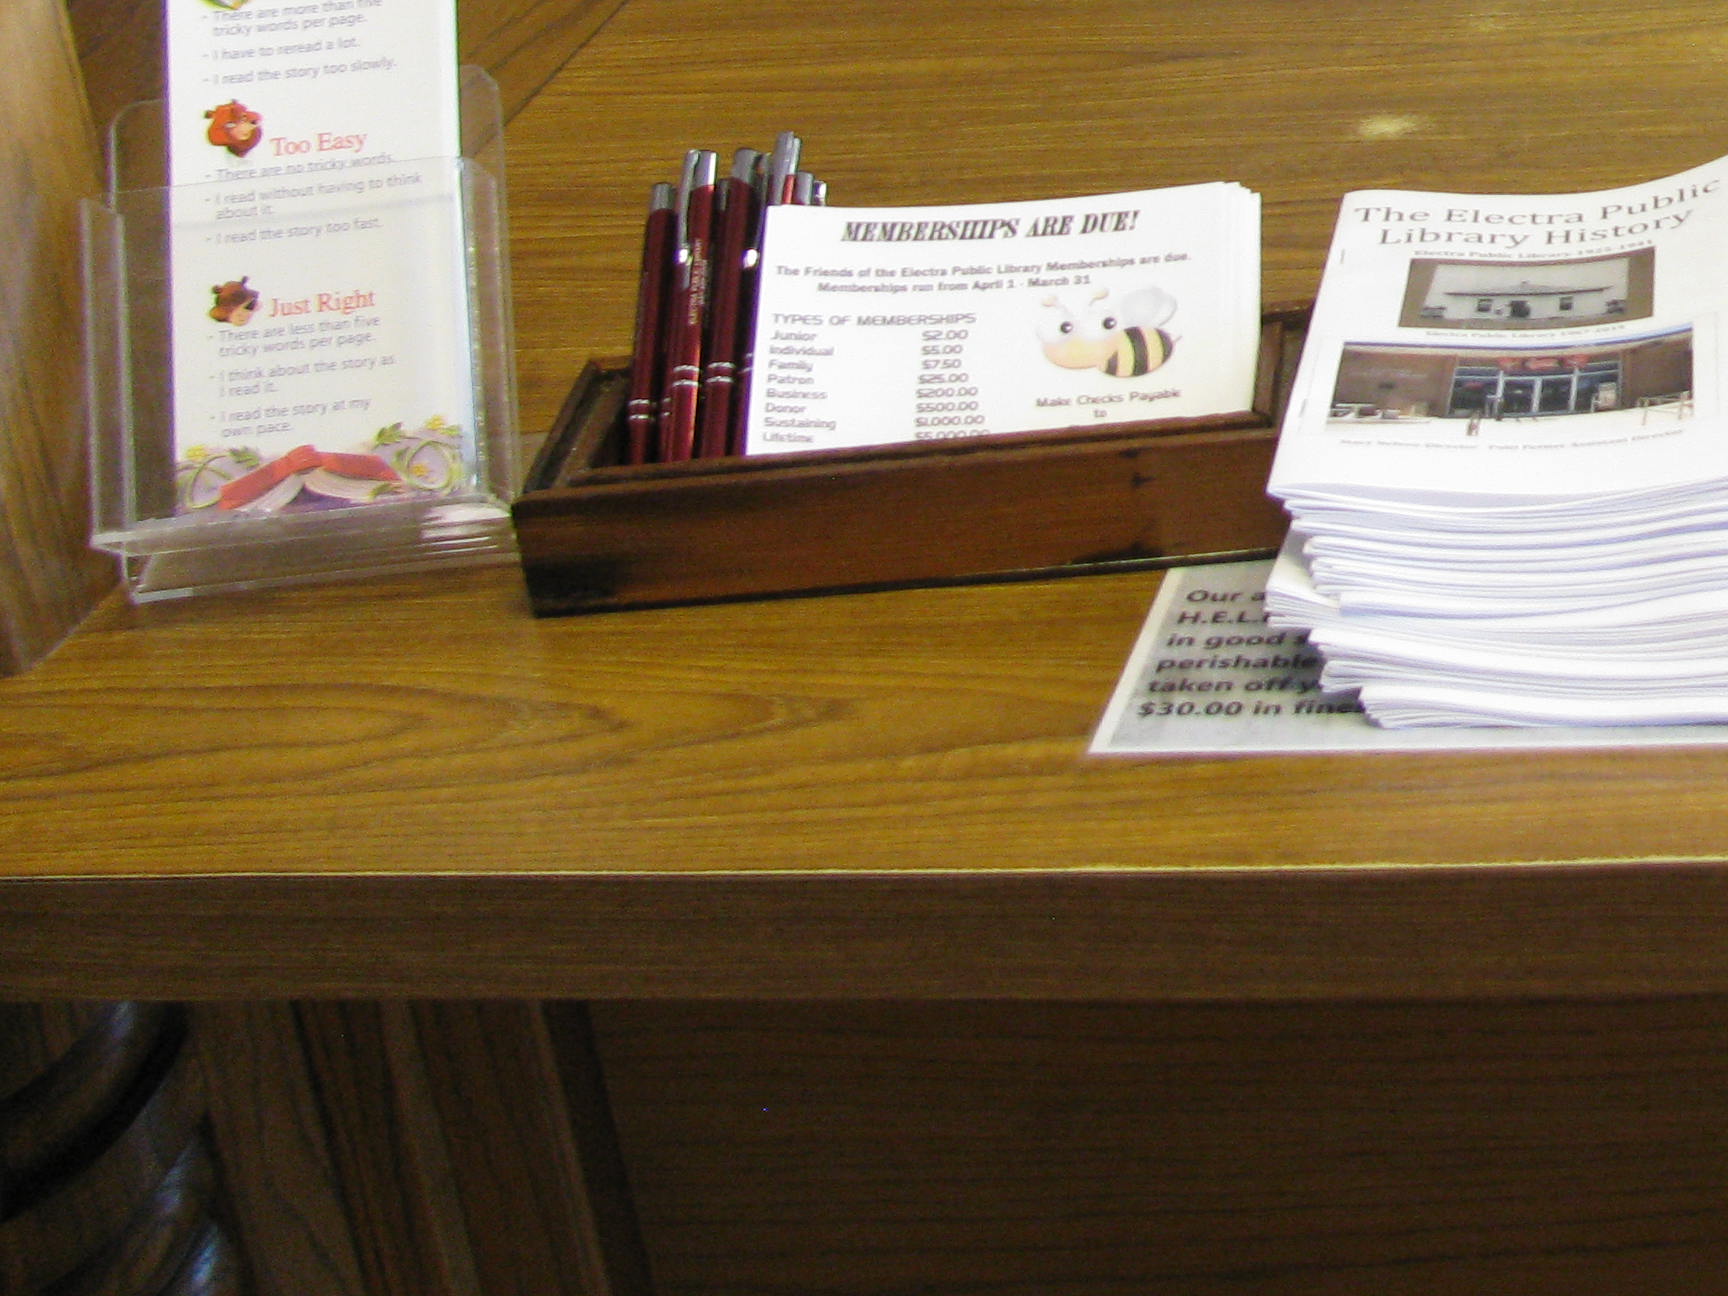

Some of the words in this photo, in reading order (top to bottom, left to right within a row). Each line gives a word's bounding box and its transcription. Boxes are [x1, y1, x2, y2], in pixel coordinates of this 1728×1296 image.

[268, 136, 311, 156] Too
[315, 133, 366, 153] Easy
[1355, 207, 1430, 223] The
[1446, 208, 1584, 226] Electra
[1601, 179, 1722, 220] Public
[841, 219, 1019, 242] MEMBERSHIPS
[1026, 215, 1074, 237] ARE
[1080, 210, 1139, 234] DUE!
[1379, 227, 1531, 249] Library
[1546, 209, 1695, 245] History
[267, 298, 310, 318] Just
[314, 290, 375, 314] Right
[774, 313, 823, 325] TYPES
[829, 315, 849, 326] OF
[856, 312, 976, 325] MEMBERSHIPS
[922, 329, 968, 341] $2.00
[1186, 589, 1242, 603] Our
[1167, 633, 1195, 647] in
[1203, 632, 1287, 650] good
[1148, 679, 1234, 692] taken
[1244, 676, 1291, 692] off
[1137, 700, 1243, 718] $30.00
[1253, 701, 1281, 715] in
